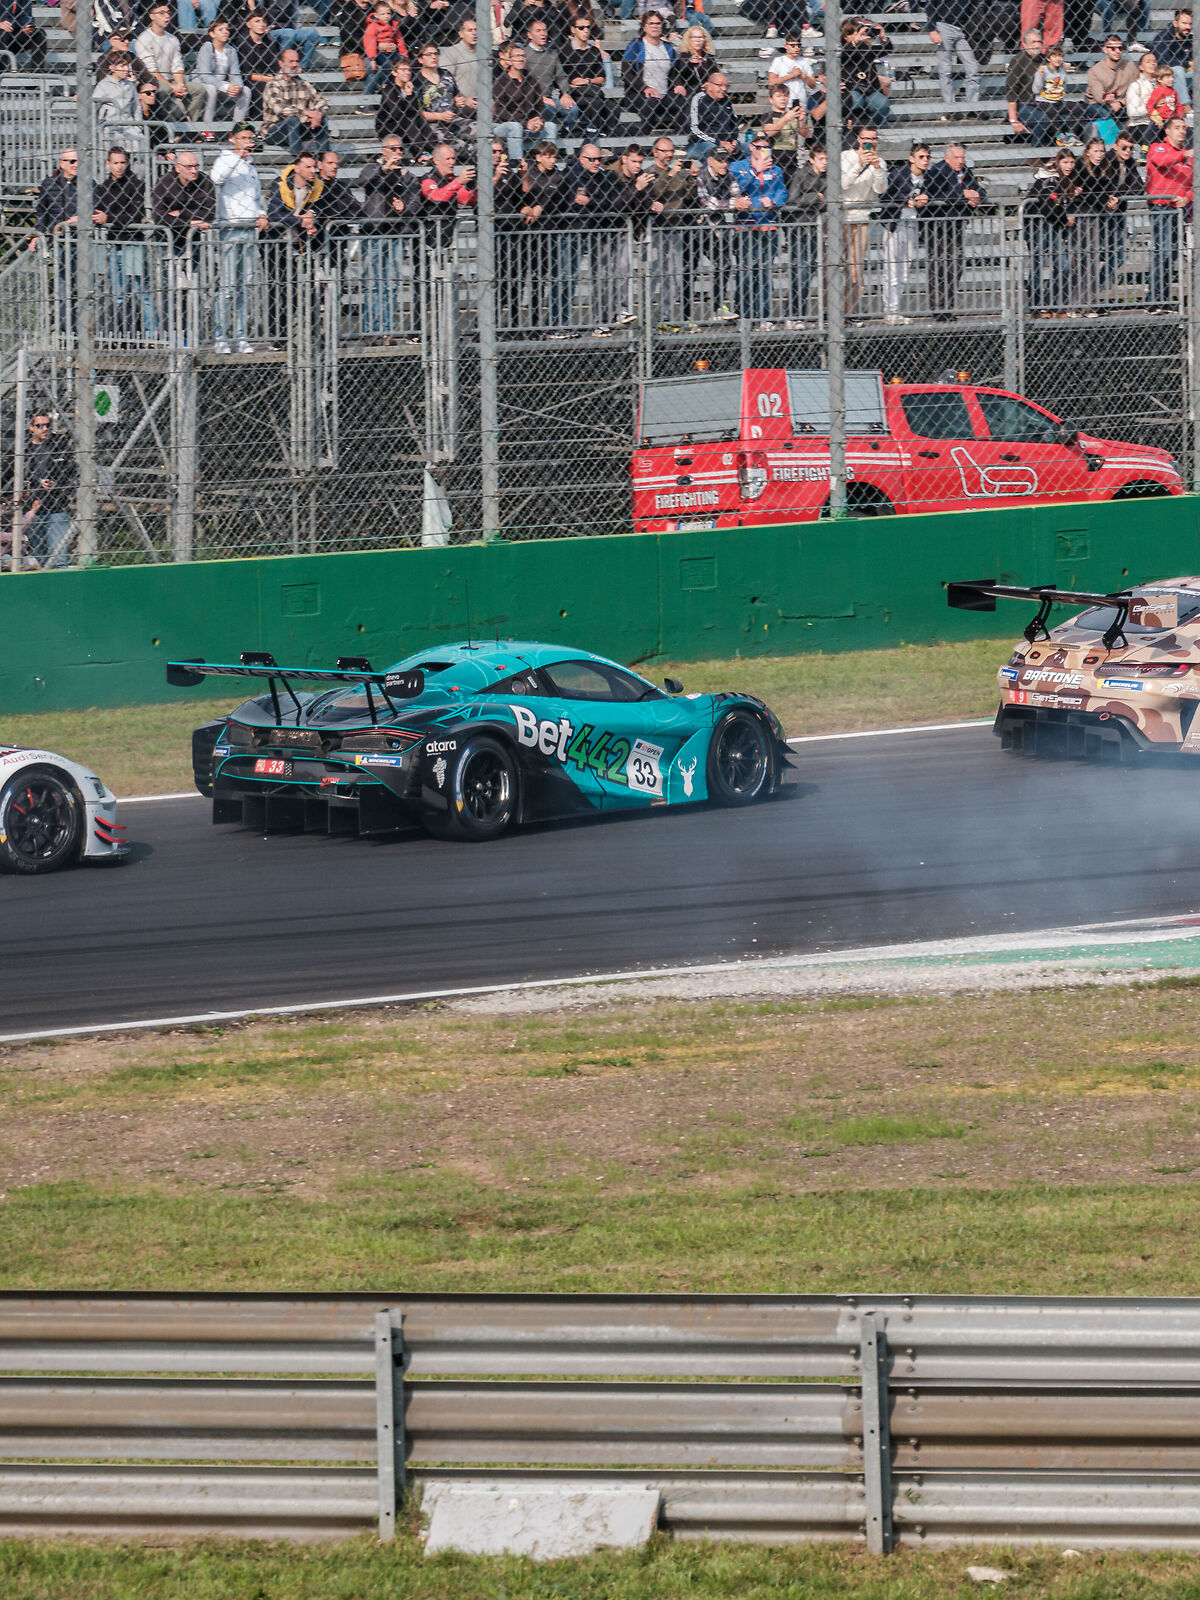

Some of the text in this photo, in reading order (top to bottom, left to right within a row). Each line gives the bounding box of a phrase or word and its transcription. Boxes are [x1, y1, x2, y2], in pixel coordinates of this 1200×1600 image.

[757, 393, 783, 418] 02
[722, 453, 733, 465] 02
[773, 466, 854, 482] FIREFIGHTG
[655, 490, 719, 510] FIREFIGHTING
[1023, 669, 1085, 685] BARTONE
[1018, 692, 1024, 703] 9
[426, 740, 456, 752] atara
[269, 759, 284, 773] 33
[633, 758, 657, 788] 33
